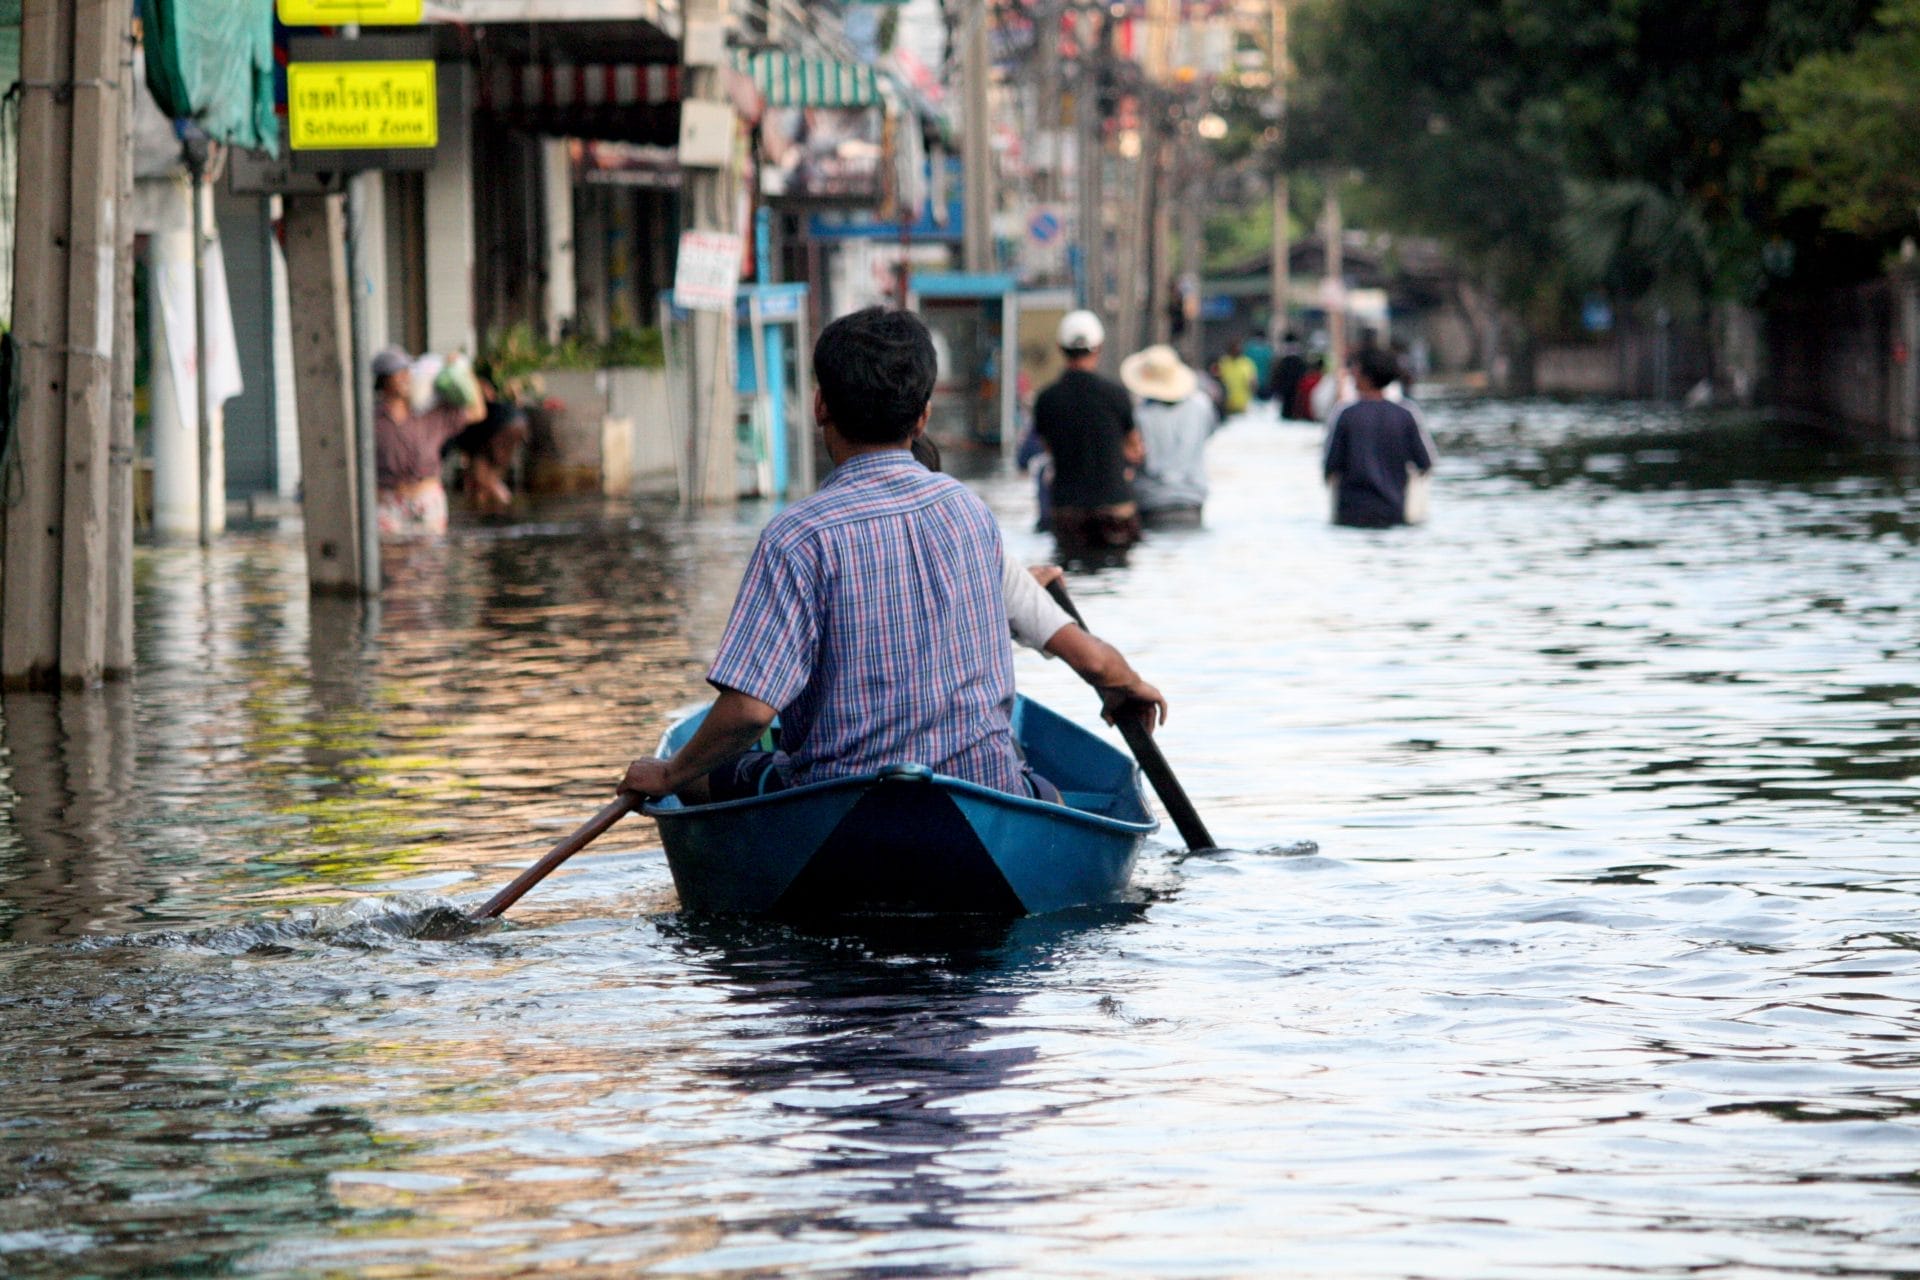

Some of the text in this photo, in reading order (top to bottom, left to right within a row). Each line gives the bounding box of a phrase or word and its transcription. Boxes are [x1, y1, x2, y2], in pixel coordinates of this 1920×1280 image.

[299, 76, 424, 108] เขตโรงเรียน
[304, 118, 423, 136] School Zone
